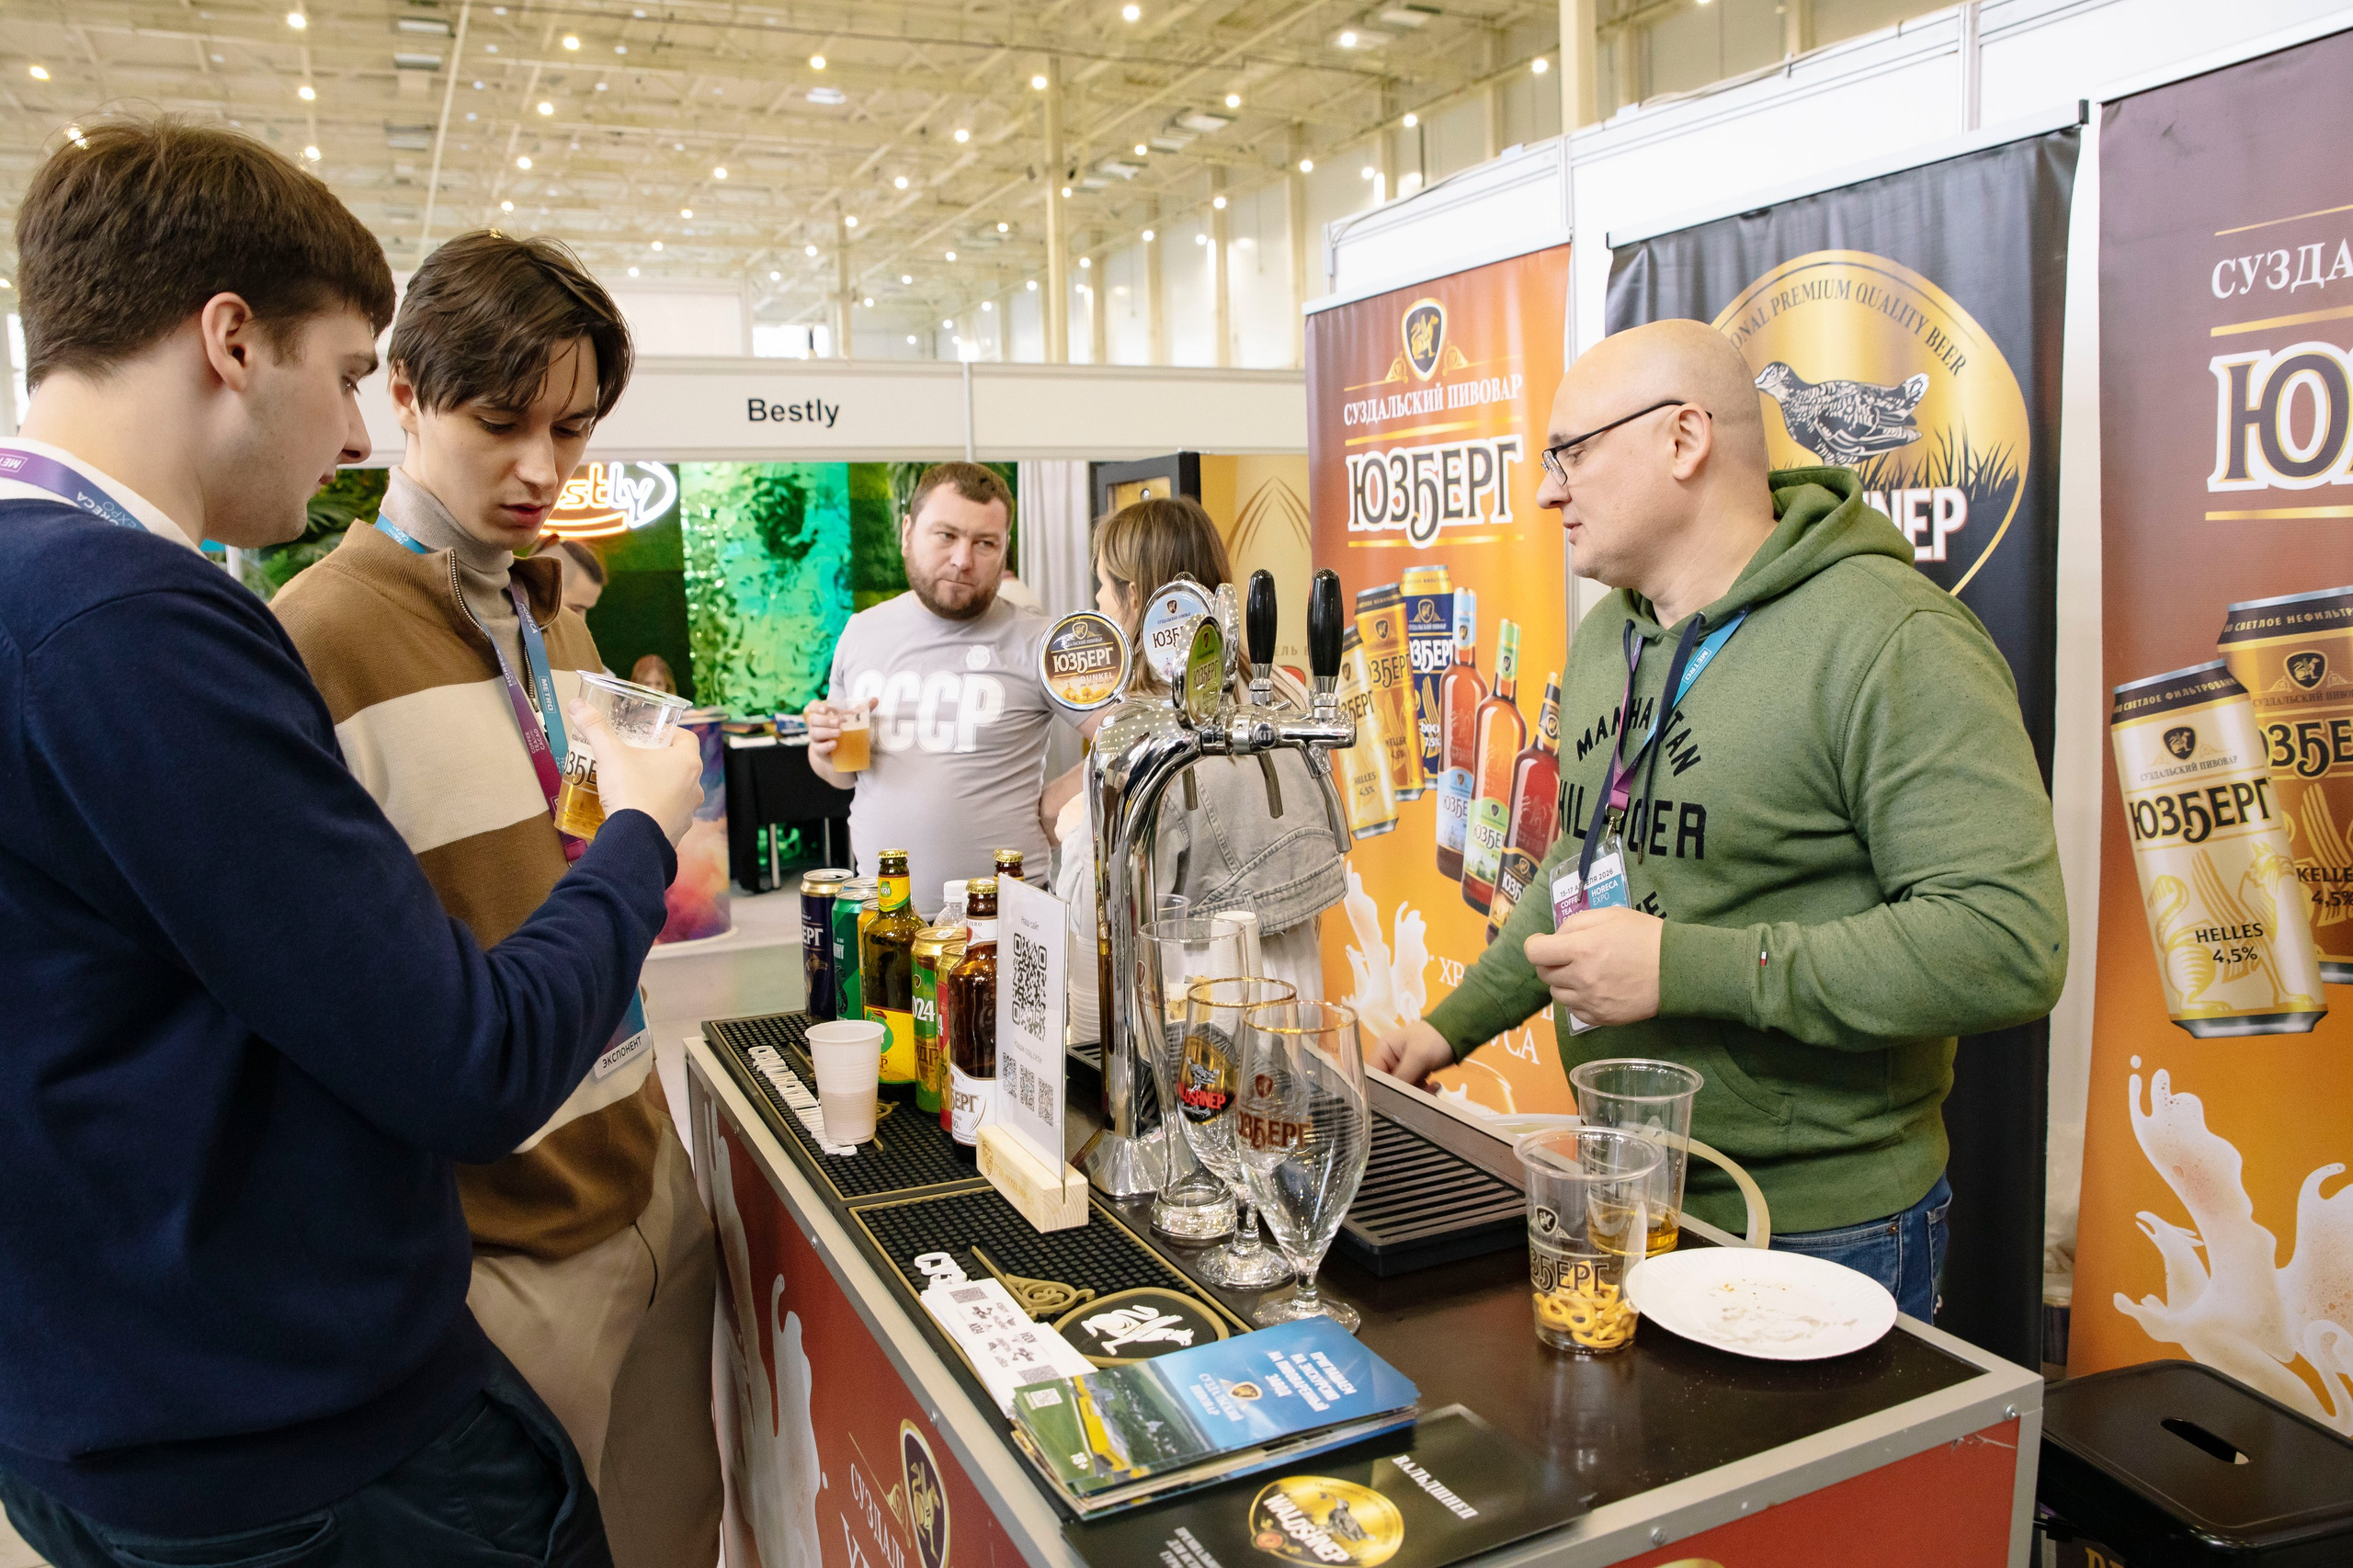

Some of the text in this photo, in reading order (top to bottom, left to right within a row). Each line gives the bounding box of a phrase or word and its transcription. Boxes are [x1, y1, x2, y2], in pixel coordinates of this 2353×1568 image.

[1770, 278, 1851, 317] PREMIUM
[1855, 281, 1931, 335] QUALITY
[1924, 324, 1967, 377] BEER
[746, 397, 840, 428] Bestly
[1343, 373, 1523, 426] СУЗДАЛЬСКИЙ ПИВОВАР
[2207, 340, 2353, 493] Ю
[554, 461, 677, 529] stly
[1346, 433, 1524, 550] ЮЗБЕРГ
[1153, 625, 1184, 649] ЮЗБ
[1052, 646, 1114, 674] ЮЗБЕРГ
[1368, 653, 1411, 688] ЗБЕРГ
[1684, 650, 1711, 682] METRO
[1080, 671, 1114, 683] DUNKEL
[540, 678, 555, 712] METRO
[1576, 696, 1702, 778] MANHATAN
[2258, 719, 2353, 778] ЗБЕ
[2199, 755, 2239, 772] ПИВОВАР
[2129, 776, 2272, 845] ЮЗБЕРГ
[1472, 822, 1506, 850] ЮЗБЕ
[1502, 870, 1526, 903] ЮЗБ
[1590, 879, 1619, 897] HORECA
[1598, 868, 1614, 880] 2026
[1560, 895, 1579, 910] COFFE
[1561, 906, 1574, 916] TEA
[1592, 892, 1610, 906] EXPO
[2195, 921, 2265, 944] HELLES
[2211, 945, 2259, 964] 4,5%
[602, 1036, 642, 1069] ЭКСПОНЕНТ
[1391, 1454, 1479, 1520] ВАЛЬДШНЕП
